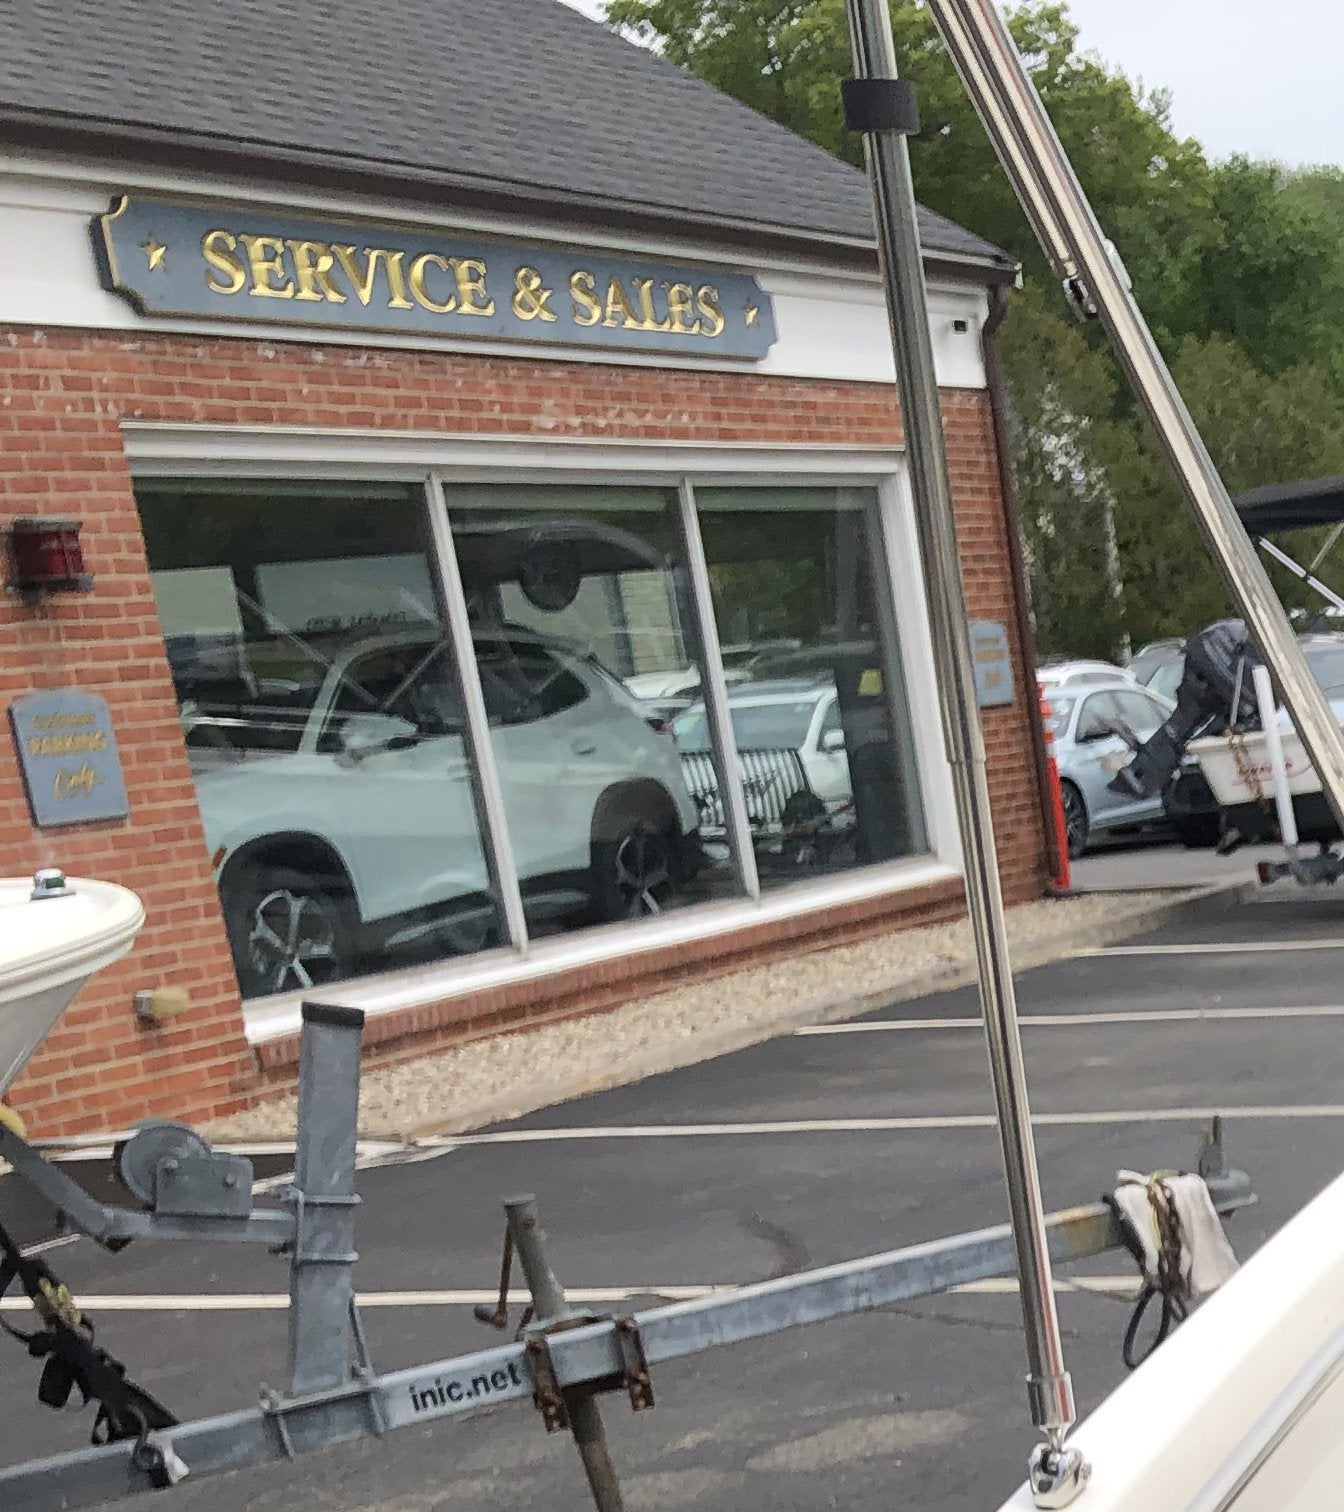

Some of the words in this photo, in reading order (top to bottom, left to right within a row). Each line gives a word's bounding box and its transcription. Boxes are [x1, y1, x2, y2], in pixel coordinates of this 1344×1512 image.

[202, 229, 494, 318] SERVICE
[511, 266, 559, 323] &
[569, 270, 726, 338] SALES
